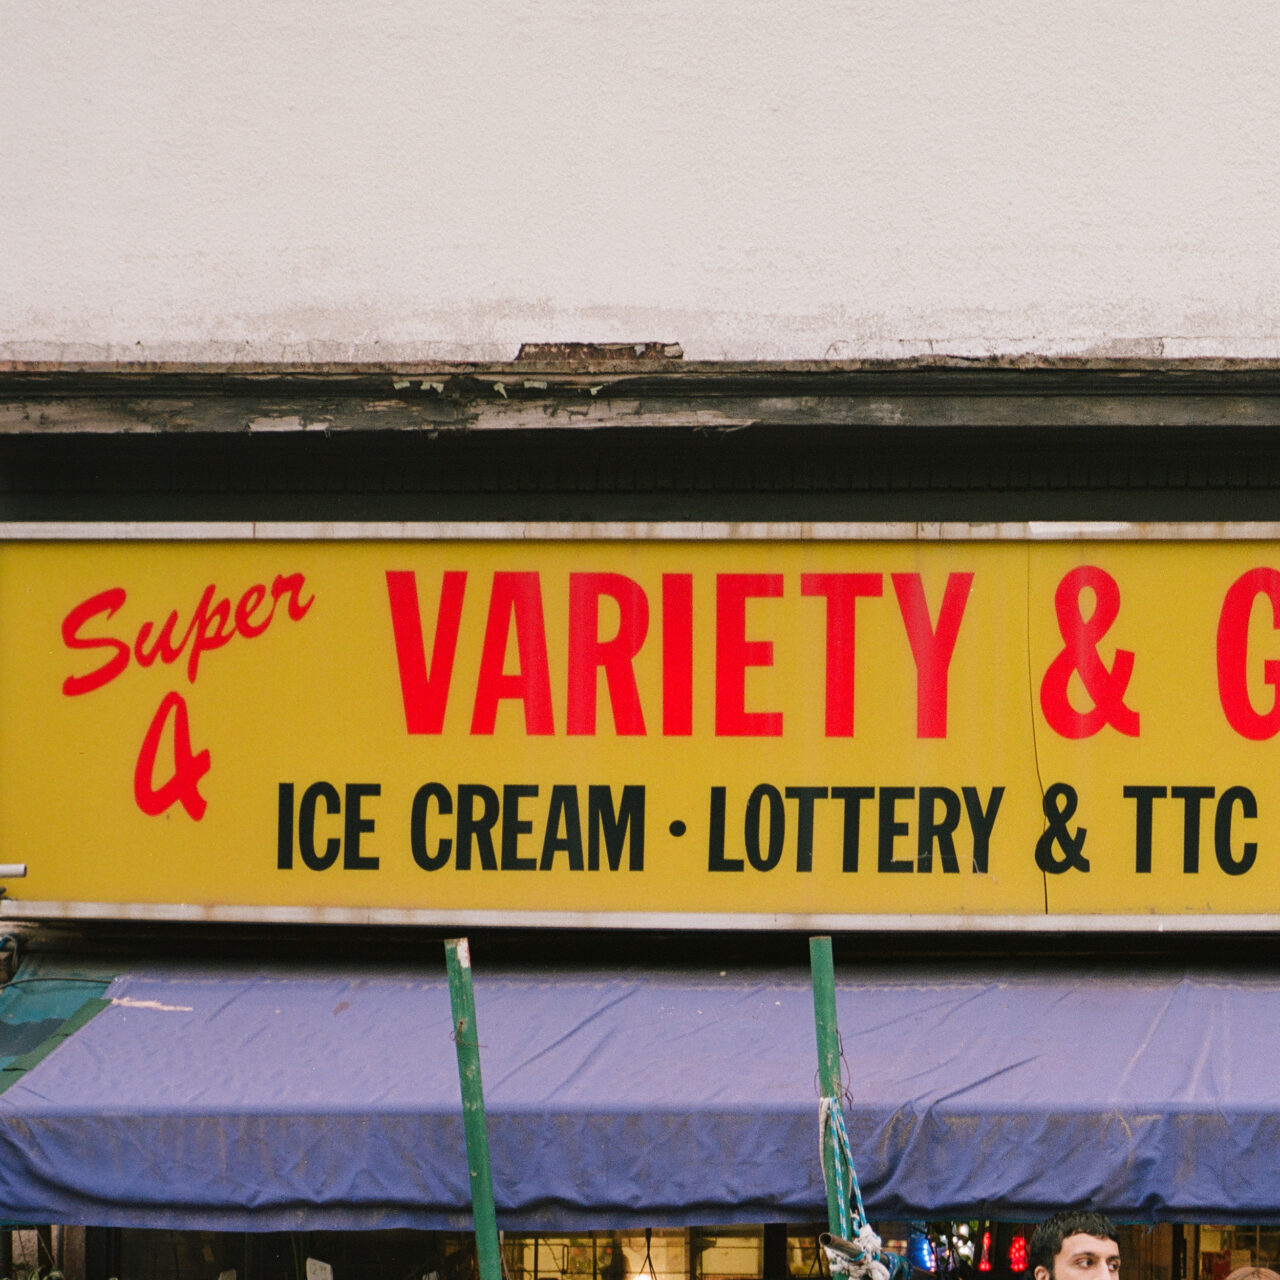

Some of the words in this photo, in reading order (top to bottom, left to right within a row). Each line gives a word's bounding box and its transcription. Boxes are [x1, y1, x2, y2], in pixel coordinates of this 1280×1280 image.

[62, 573, 315, 697] Super
[386, 569, 975, 740] VARIETY
[1039, 565, 1141, 740] &
[277, 781, 381, 872] ICE
[410, 782, 646, 873] CREAM
[708, 783, 1005, 874] LOTTERY
[1034, 782, 1090, 875] &
[1123, 785, 1259, 876] TTC
